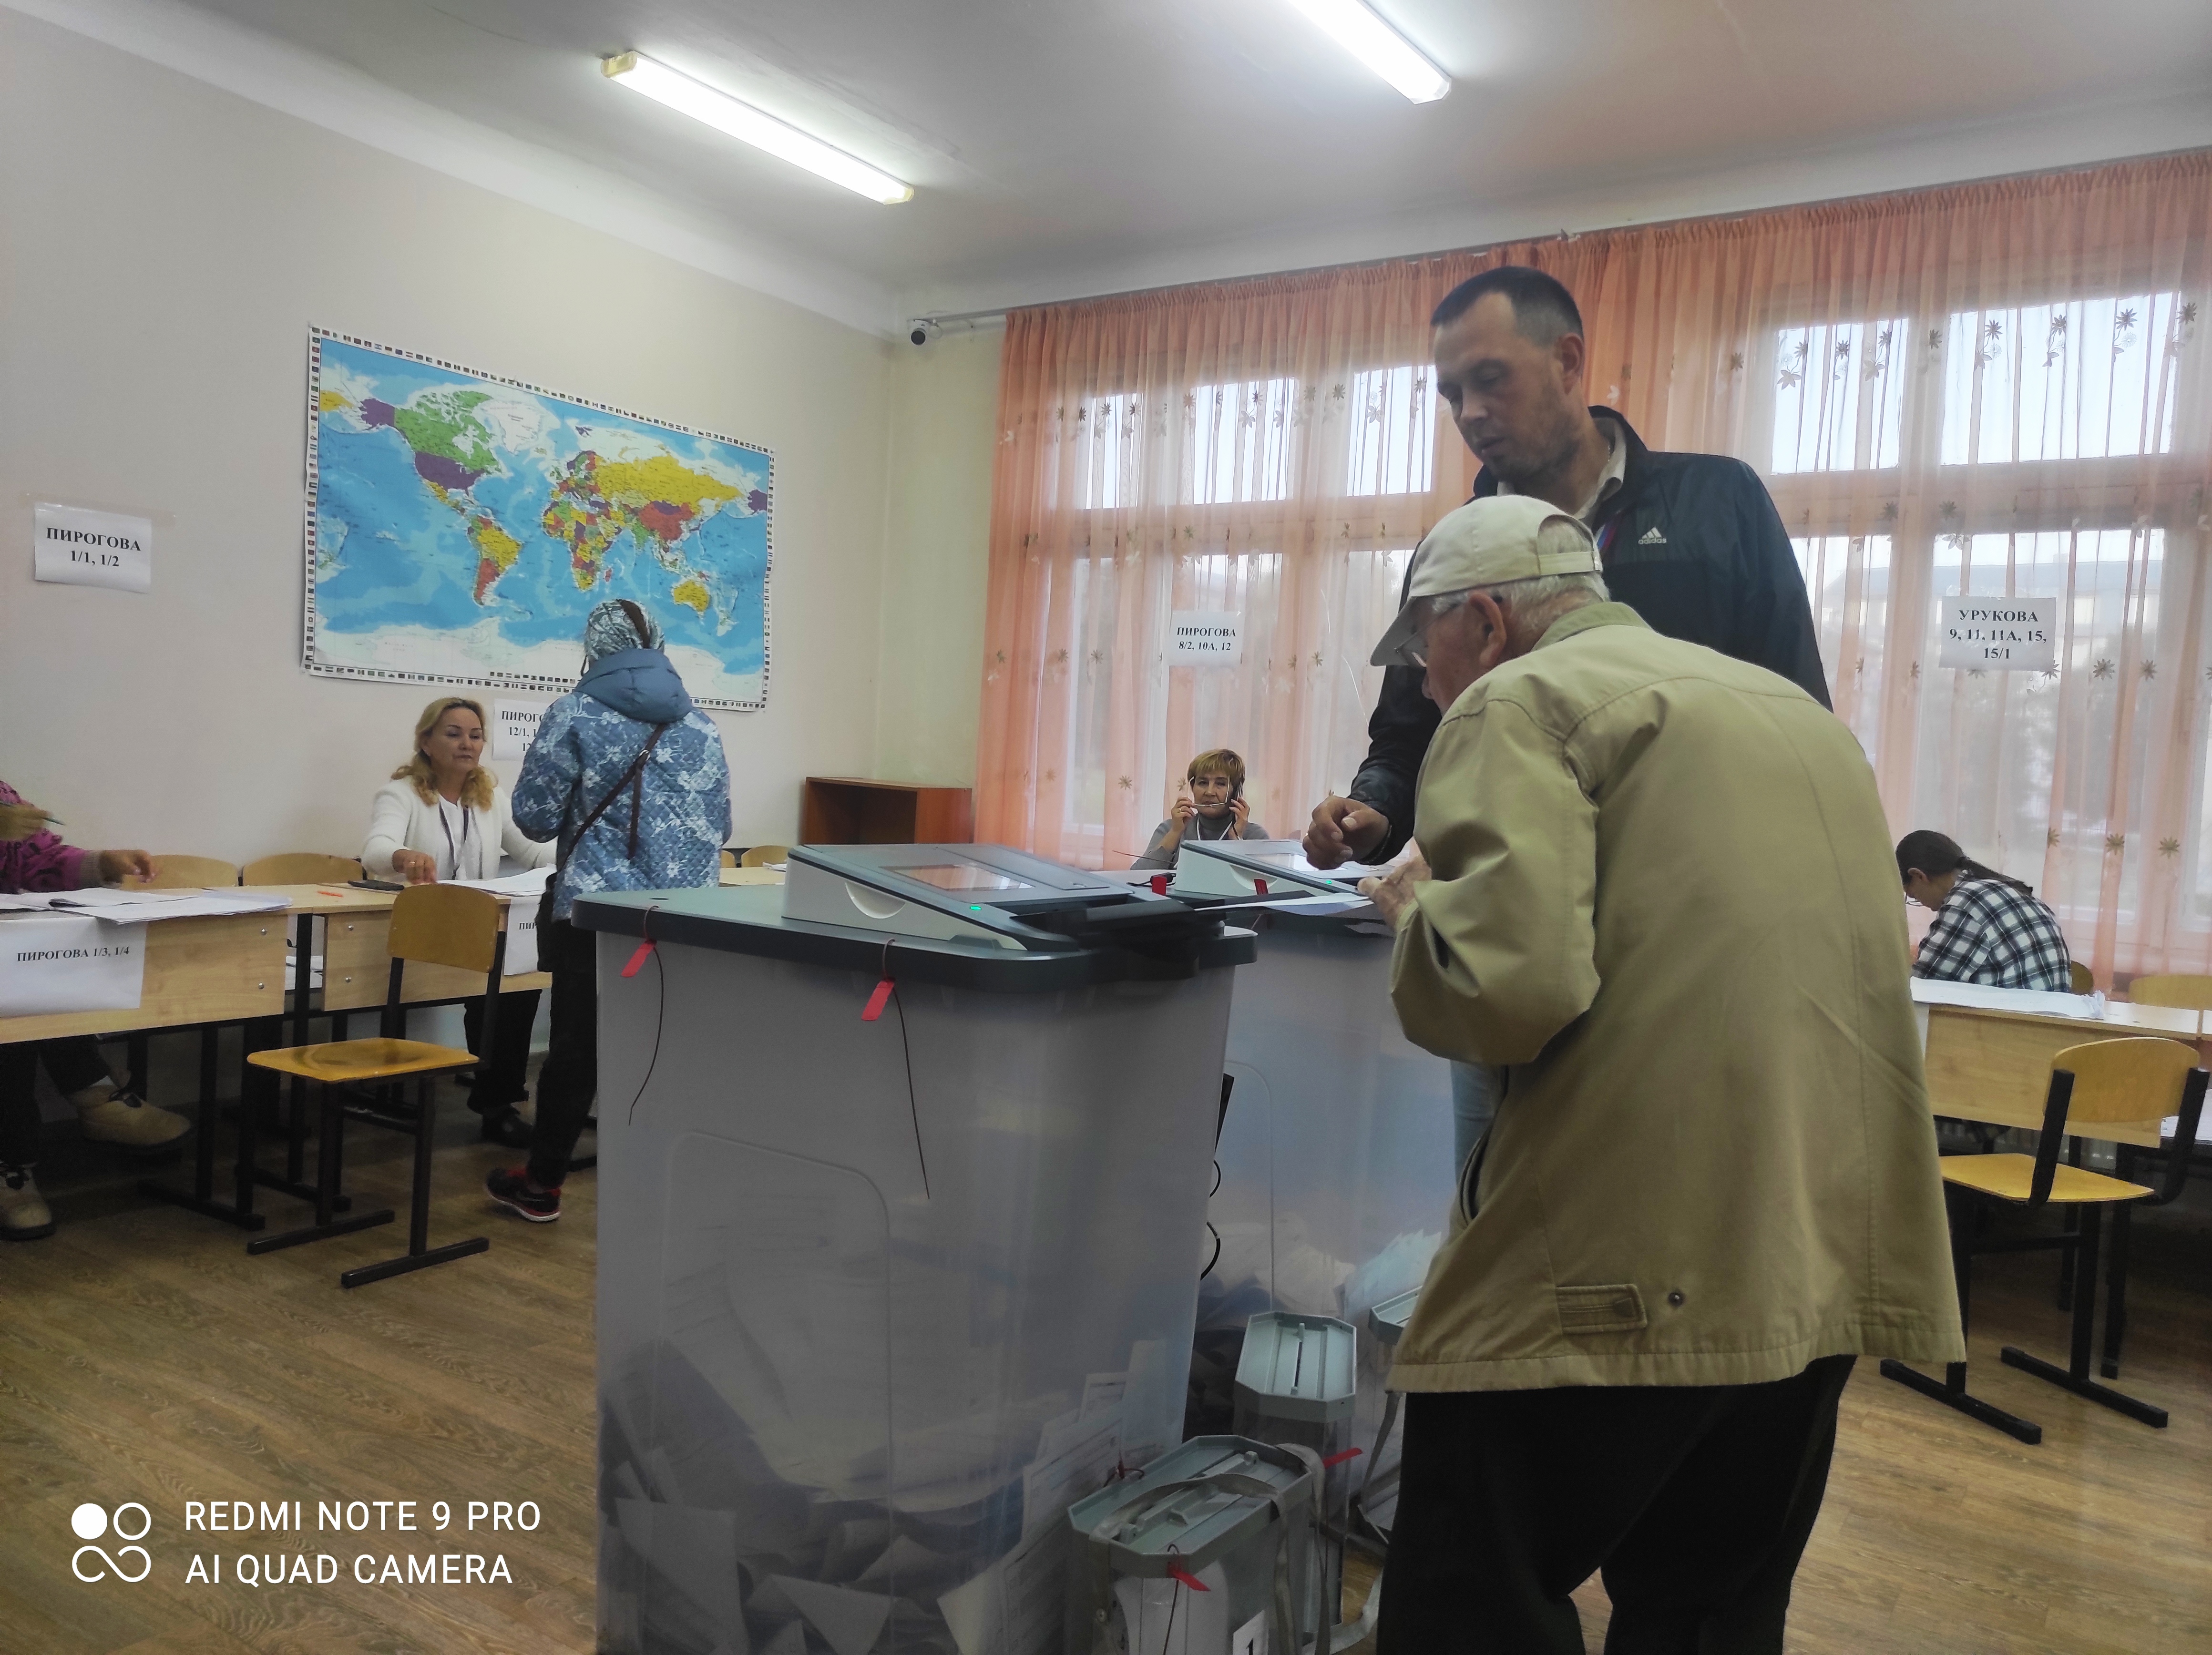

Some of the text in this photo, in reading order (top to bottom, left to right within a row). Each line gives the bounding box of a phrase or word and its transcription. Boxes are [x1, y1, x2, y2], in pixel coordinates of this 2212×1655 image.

[47, 527, 141, 551] ПИРОГОВА
[71, 550, 119, 566] 1/1, 1/2
[1959, 610, 2038, 622] УРУКОВА
[1177, 627, 1236, 636] ПИРОГОВА
[1950, 628, 2047, 643] 9, 11, 11А, 15,
[1178, 641, 1231, 651] 8/2, 10А, 12
[1984, 647, 2009, 659] 15/1
[509, 726, 529, 738] 12/1,
[17, 946, 130, 962] ПИРОГОВА 1/3, 1/4
